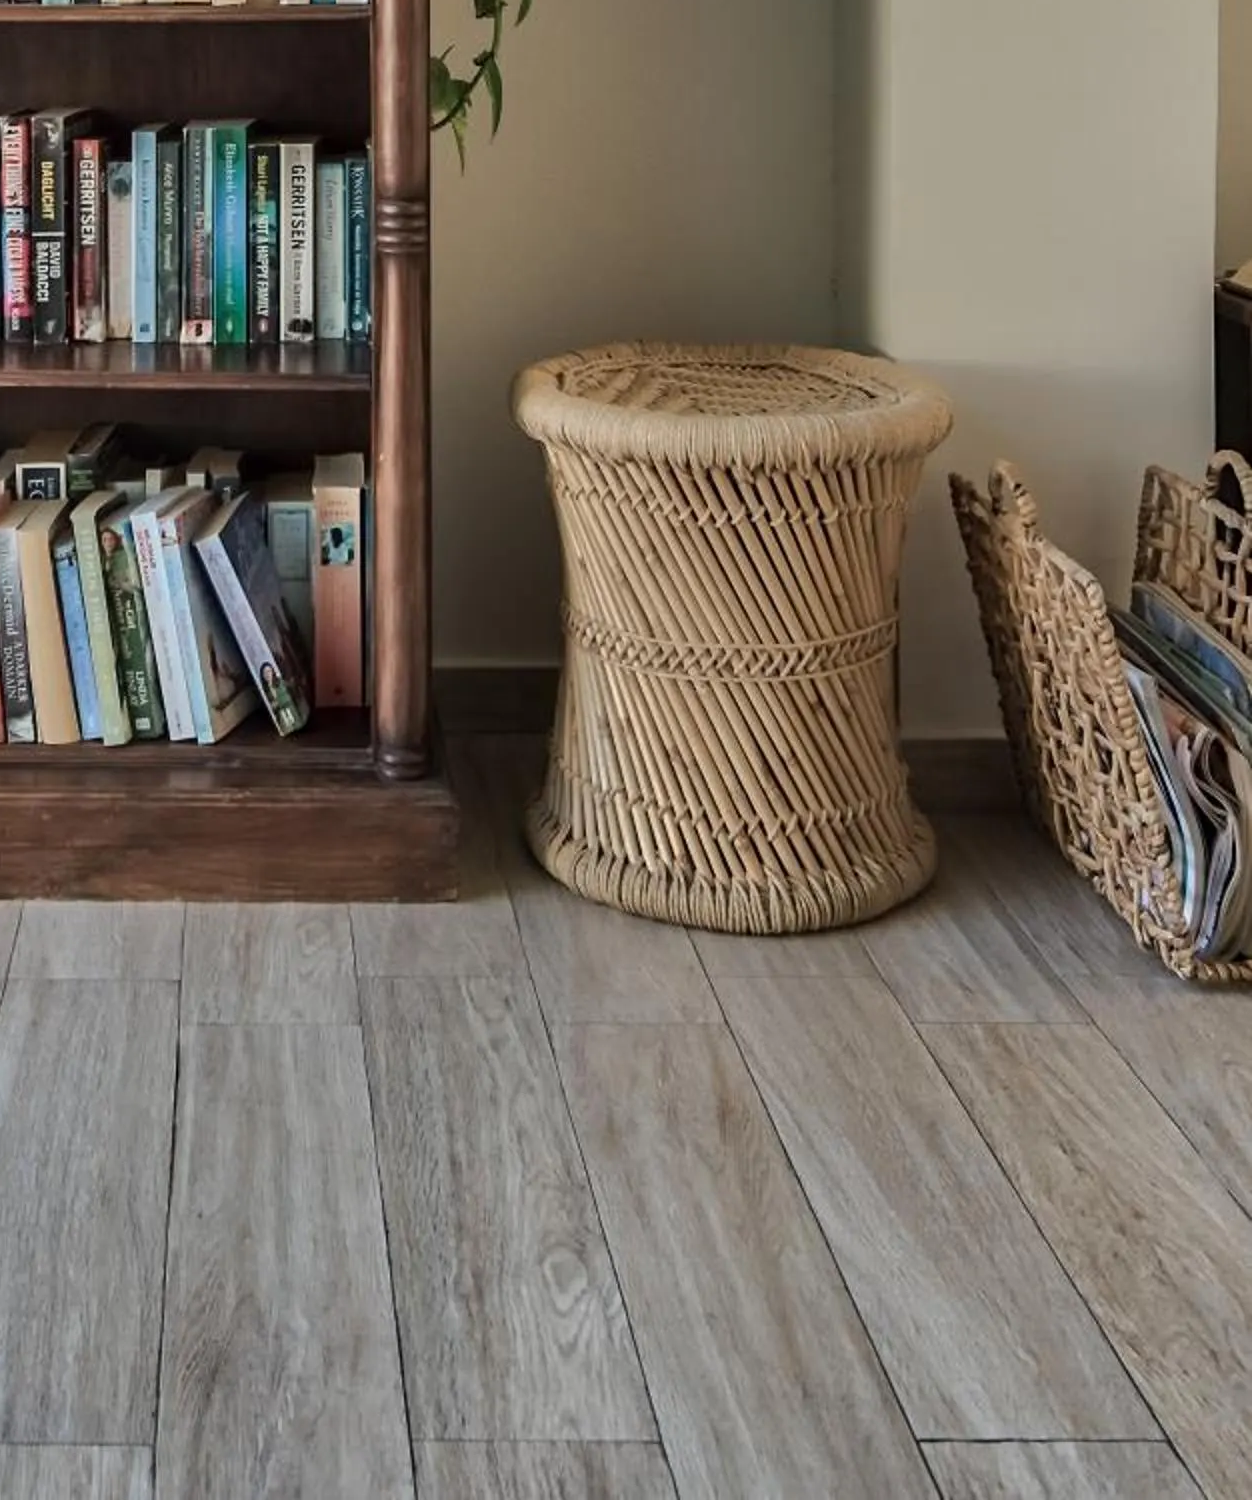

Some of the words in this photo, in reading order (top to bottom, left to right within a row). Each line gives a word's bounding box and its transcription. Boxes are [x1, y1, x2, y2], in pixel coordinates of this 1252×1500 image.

[225, 143, 237, 192] Elizabeth
[41, 160, 55, 220] DAGLICHT
[79, 159, 95, 245] GERRITSEN
[163, 189, 176, 224] Munro
[291, 164, 306, 250] GERRITSEN
[4, 207, 24, 233] FINE
[257, 214, 269, 234] NOT
[36, 241, 50, 302] BALDACCI
[49, 241, 61, 278] DAVID
[257, 246, 269, 279] HAPPY
[257, 281, 269, 316] FAMILY
[3, 647, 18, 699] DOMAIN
[135, 671, 149, 705] LINDA
